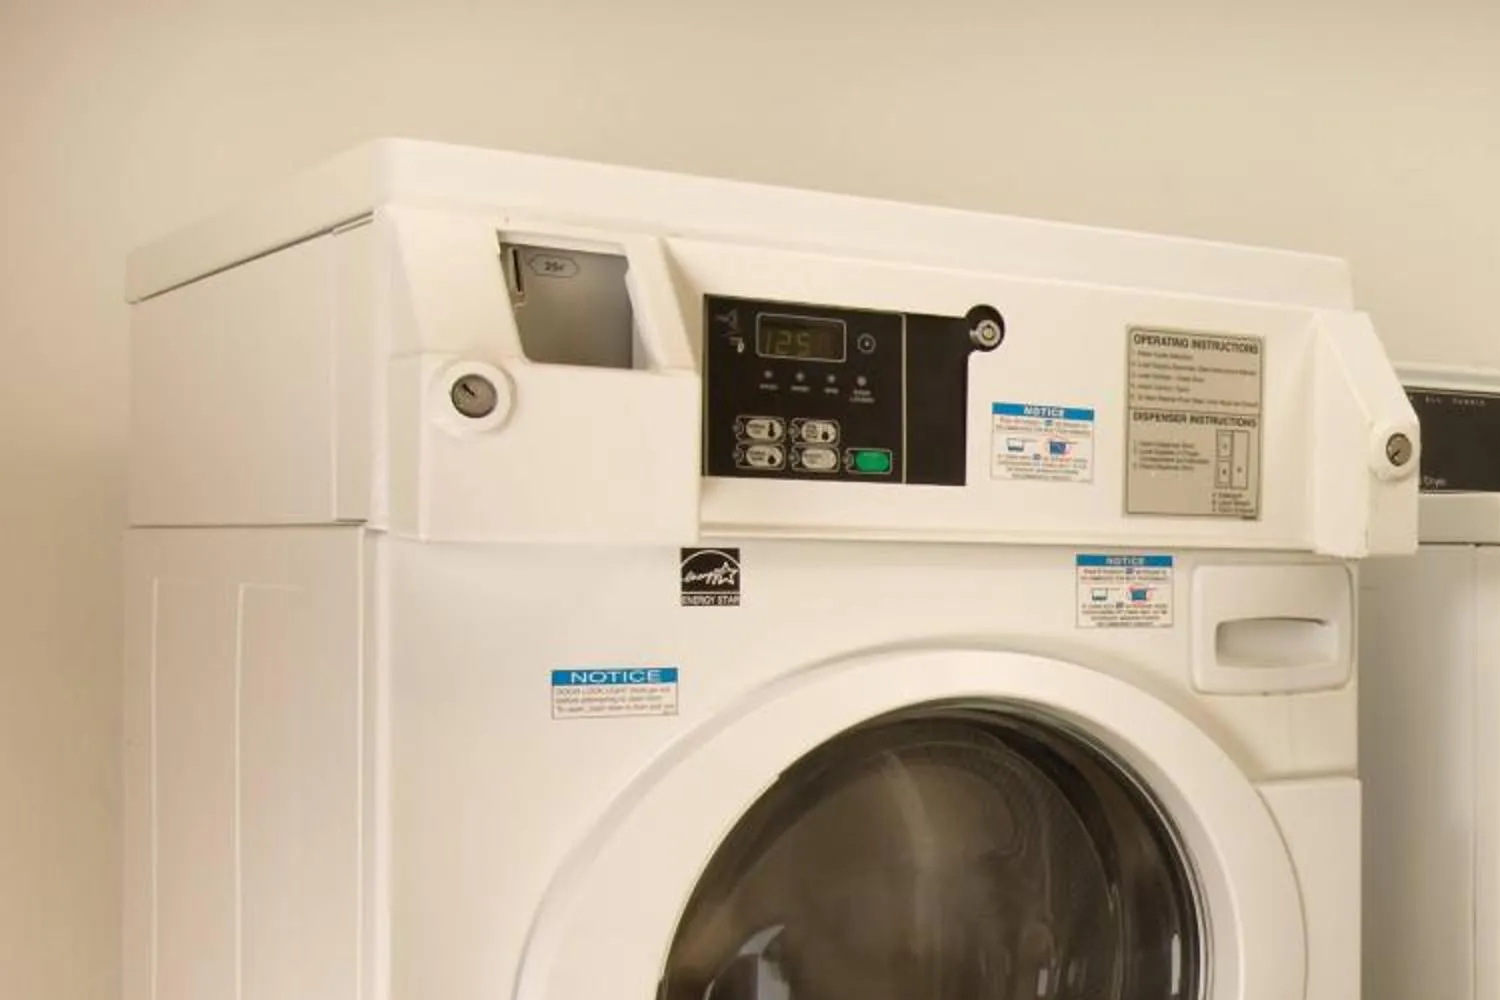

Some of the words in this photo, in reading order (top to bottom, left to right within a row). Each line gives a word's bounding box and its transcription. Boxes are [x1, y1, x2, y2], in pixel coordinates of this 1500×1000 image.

[1133, 333, 1189, 349] OPERATING
[1191, 339, 1258, 354] INSTRUCTIONS
[1024, 406, 1065, 418] NOTICE
[1133, 411, 1187, 424] DISPENSER
[1189, 414, 1257, 428] INSTRUCTIONS
[681, 595, 715, 605] ENERGY
[717, 595, 740, 605] STAR
[571, 669, 661, 683] NOTICE
